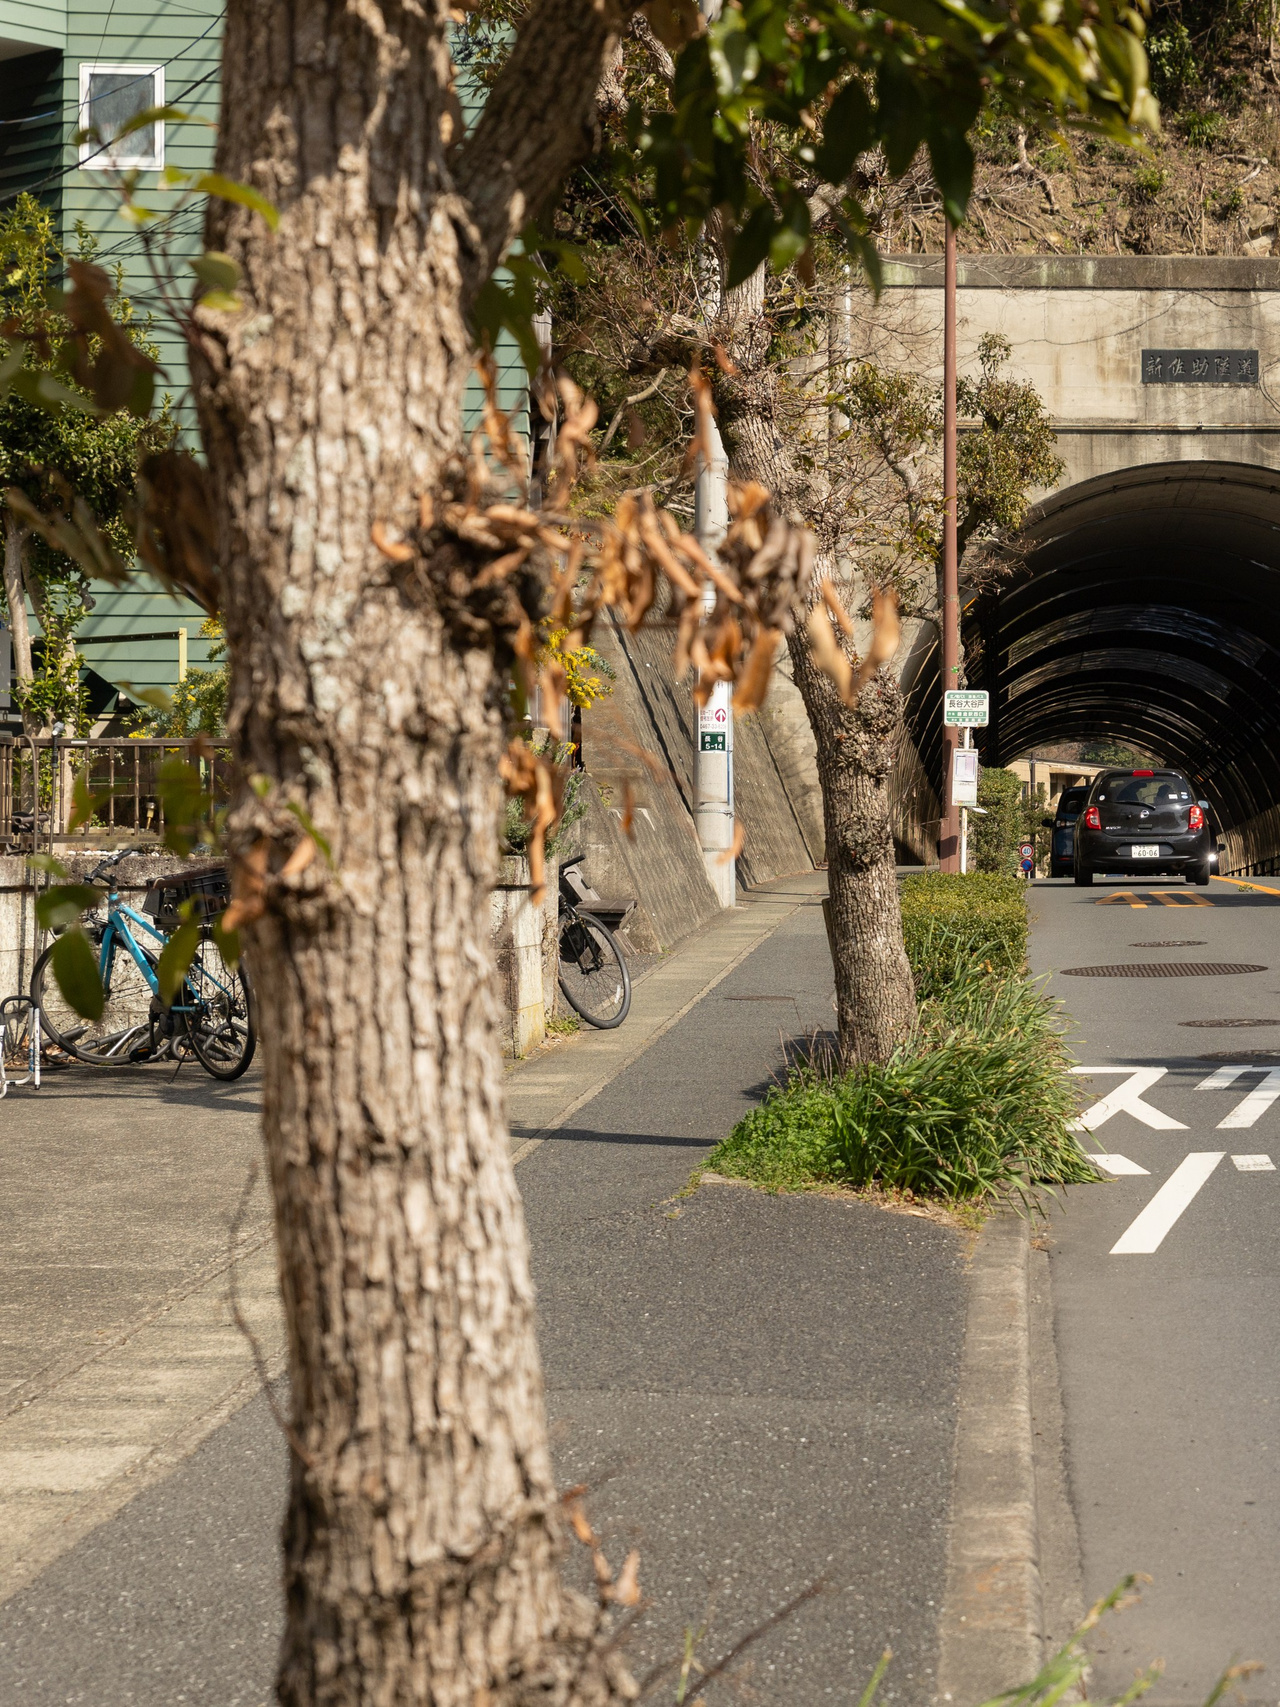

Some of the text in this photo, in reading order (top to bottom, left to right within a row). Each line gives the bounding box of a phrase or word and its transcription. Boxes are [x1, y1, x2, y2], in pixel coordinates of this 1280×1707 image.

[1145, 354, 1256, 378] 新佐助隧道
[949, 699, 985, 708] 長谷大谷戸
[1022, 847, 1032, 855] 40
[1095, 891, 1216, 909] 40
